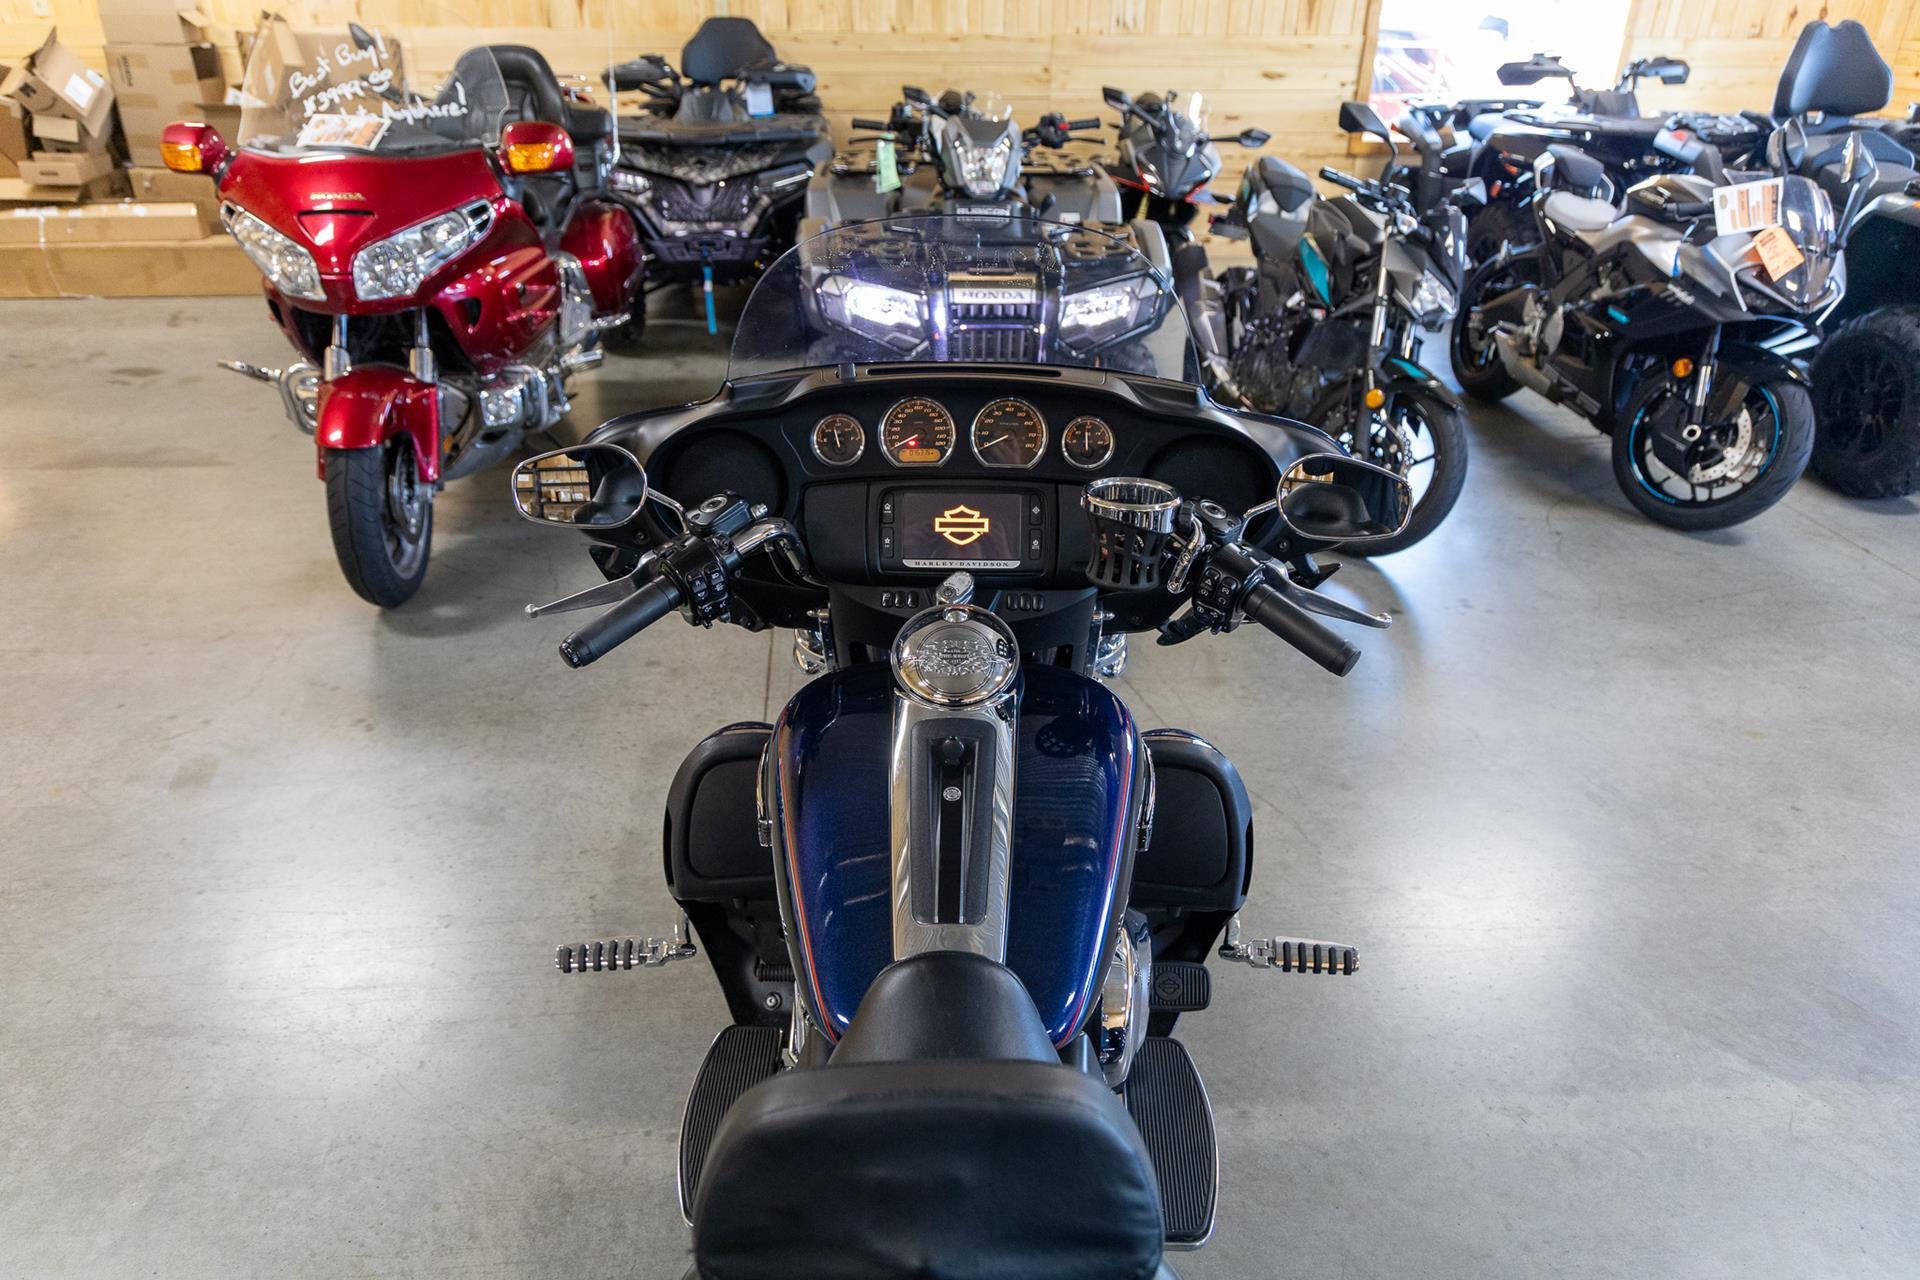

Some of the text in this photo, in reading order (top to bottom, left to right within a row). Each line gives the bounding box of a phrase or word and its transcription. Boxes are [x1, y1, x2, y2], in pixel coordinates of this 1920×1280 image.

[289, 28, 389, 98] Best Buy!
[382, 81, 469, 126] Anywhere!
[956, 206, 1011, 219] RUBICON
[961, 291, 1025, 299] HONDA
